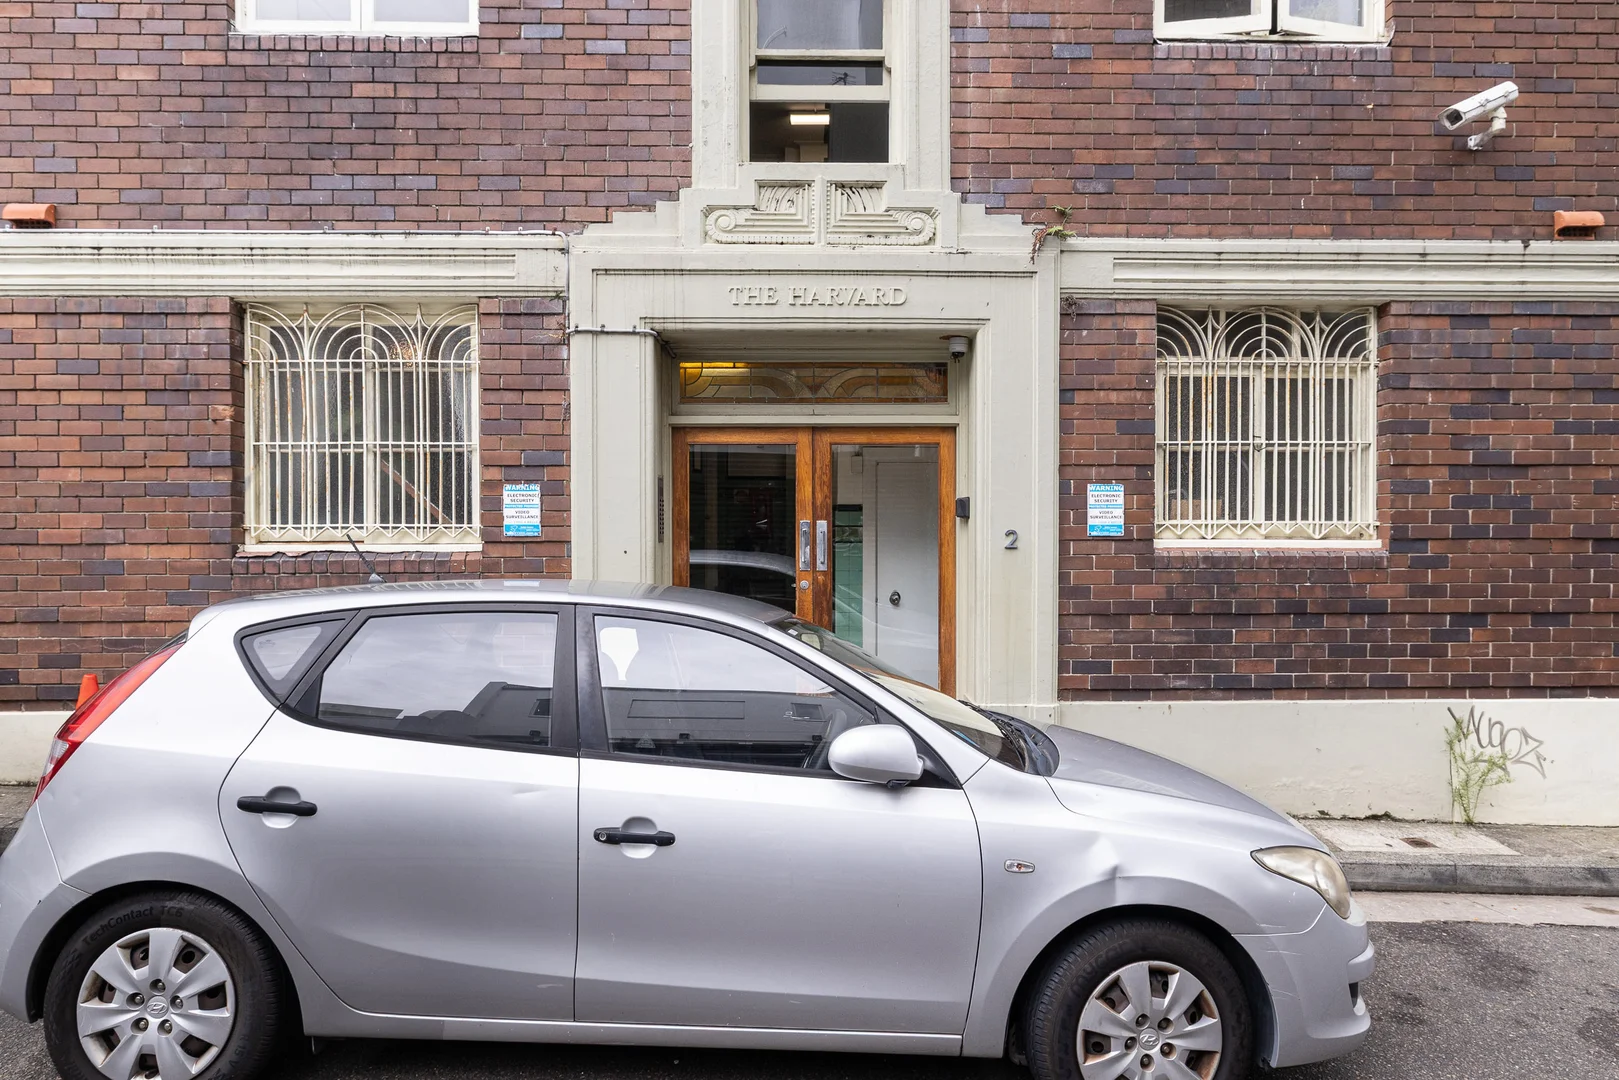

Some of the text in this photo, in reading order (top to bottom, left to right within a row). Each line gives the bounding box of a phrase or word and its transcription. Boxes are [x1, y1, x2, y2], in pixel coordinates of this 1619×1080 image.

[728, 286, 908, 307] THE HARVARD
[1004, 529, 1018, 550] 2
[82, 905, 185, 946] TechContact TC6
